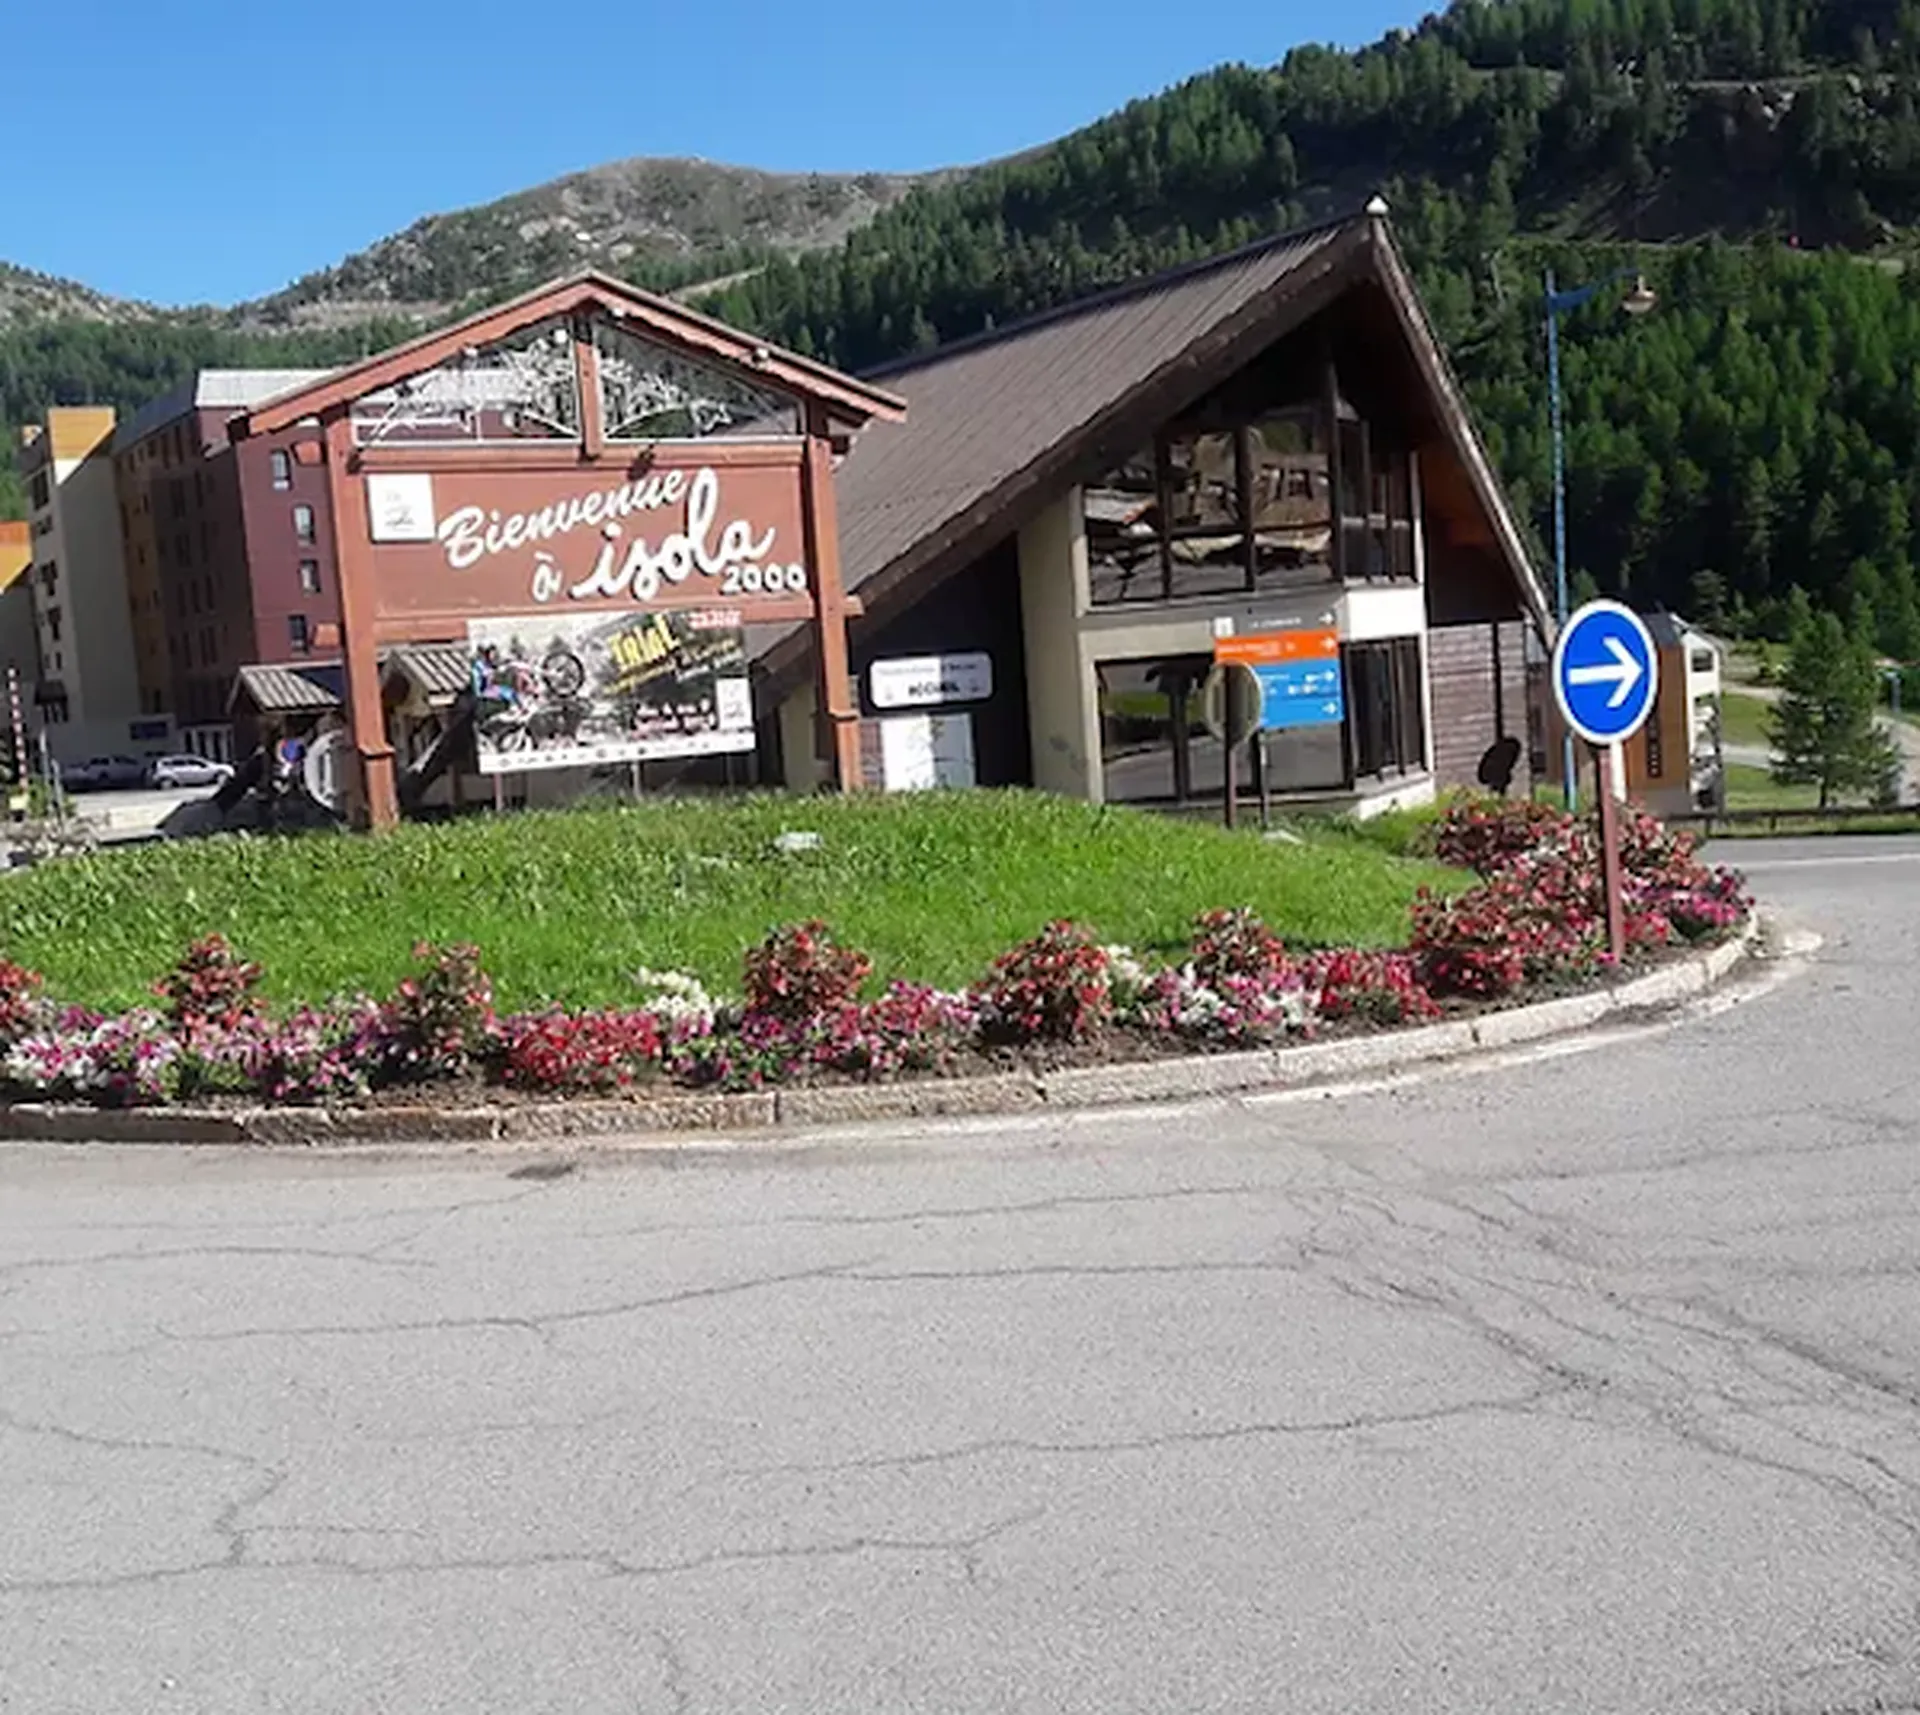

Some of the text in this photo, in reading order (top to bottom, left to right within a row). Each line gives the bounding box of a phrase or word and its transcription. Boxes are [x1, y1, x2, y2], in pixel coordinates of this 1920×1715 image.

[439, 469, 687, 568] Bienvenue
[533, 467, 777, 602] à isola
[722, 562, 808, 594] 2000
